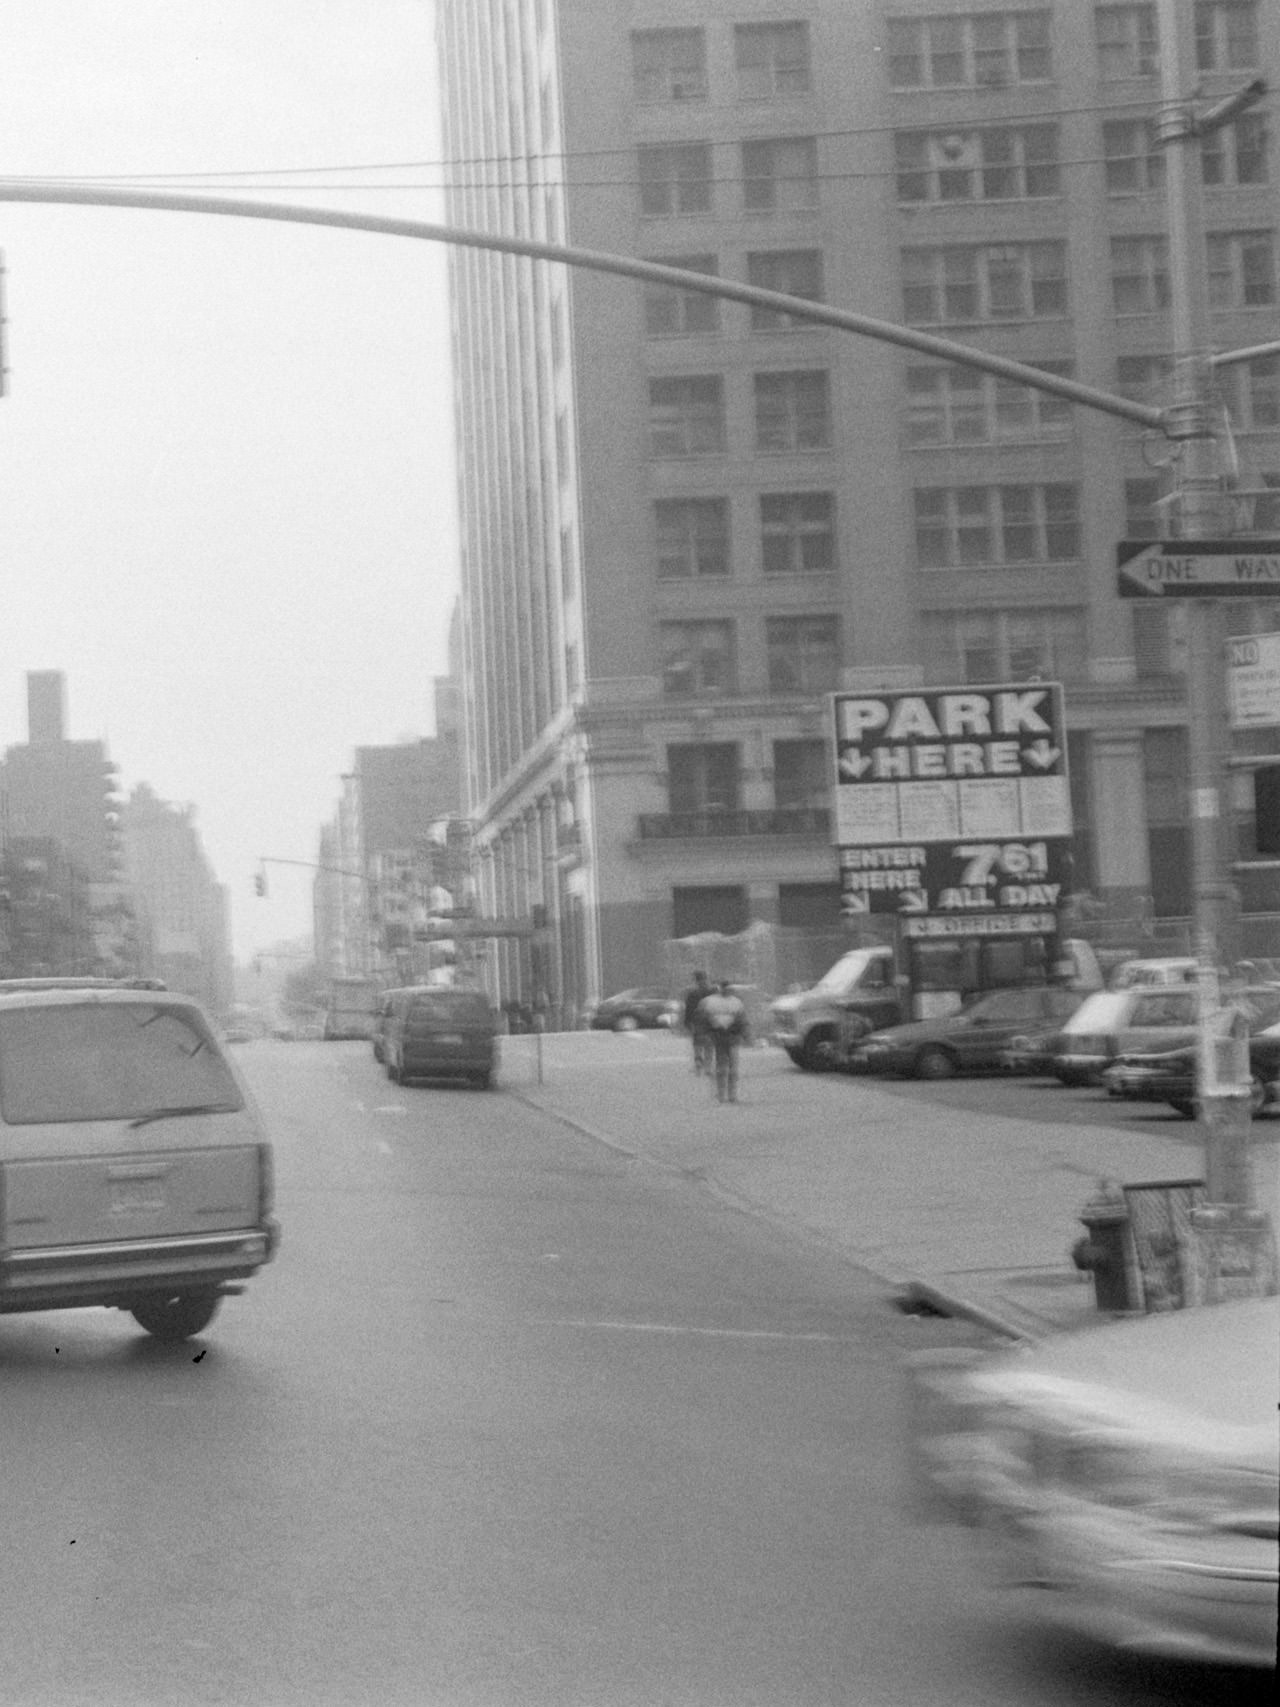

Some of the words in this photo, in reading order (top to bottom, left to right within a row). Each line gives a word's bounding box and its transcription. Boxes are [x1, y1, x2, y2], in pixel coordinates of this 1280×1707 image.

[1147, 558, 1199, 580] ONE
[1233, 642, 1258, 664] NO
[838, 690, 1052, 741] PARK
[871, 740, 1022, 778] HERE
[841, 847, 927, 869] ENTER
[843, 869, 921, 891] HERE
[937, 887, 996, 909] ALL
[1000, 883, 1061, 907] DAY
[941, 915, 1021, 935] OFFICE
